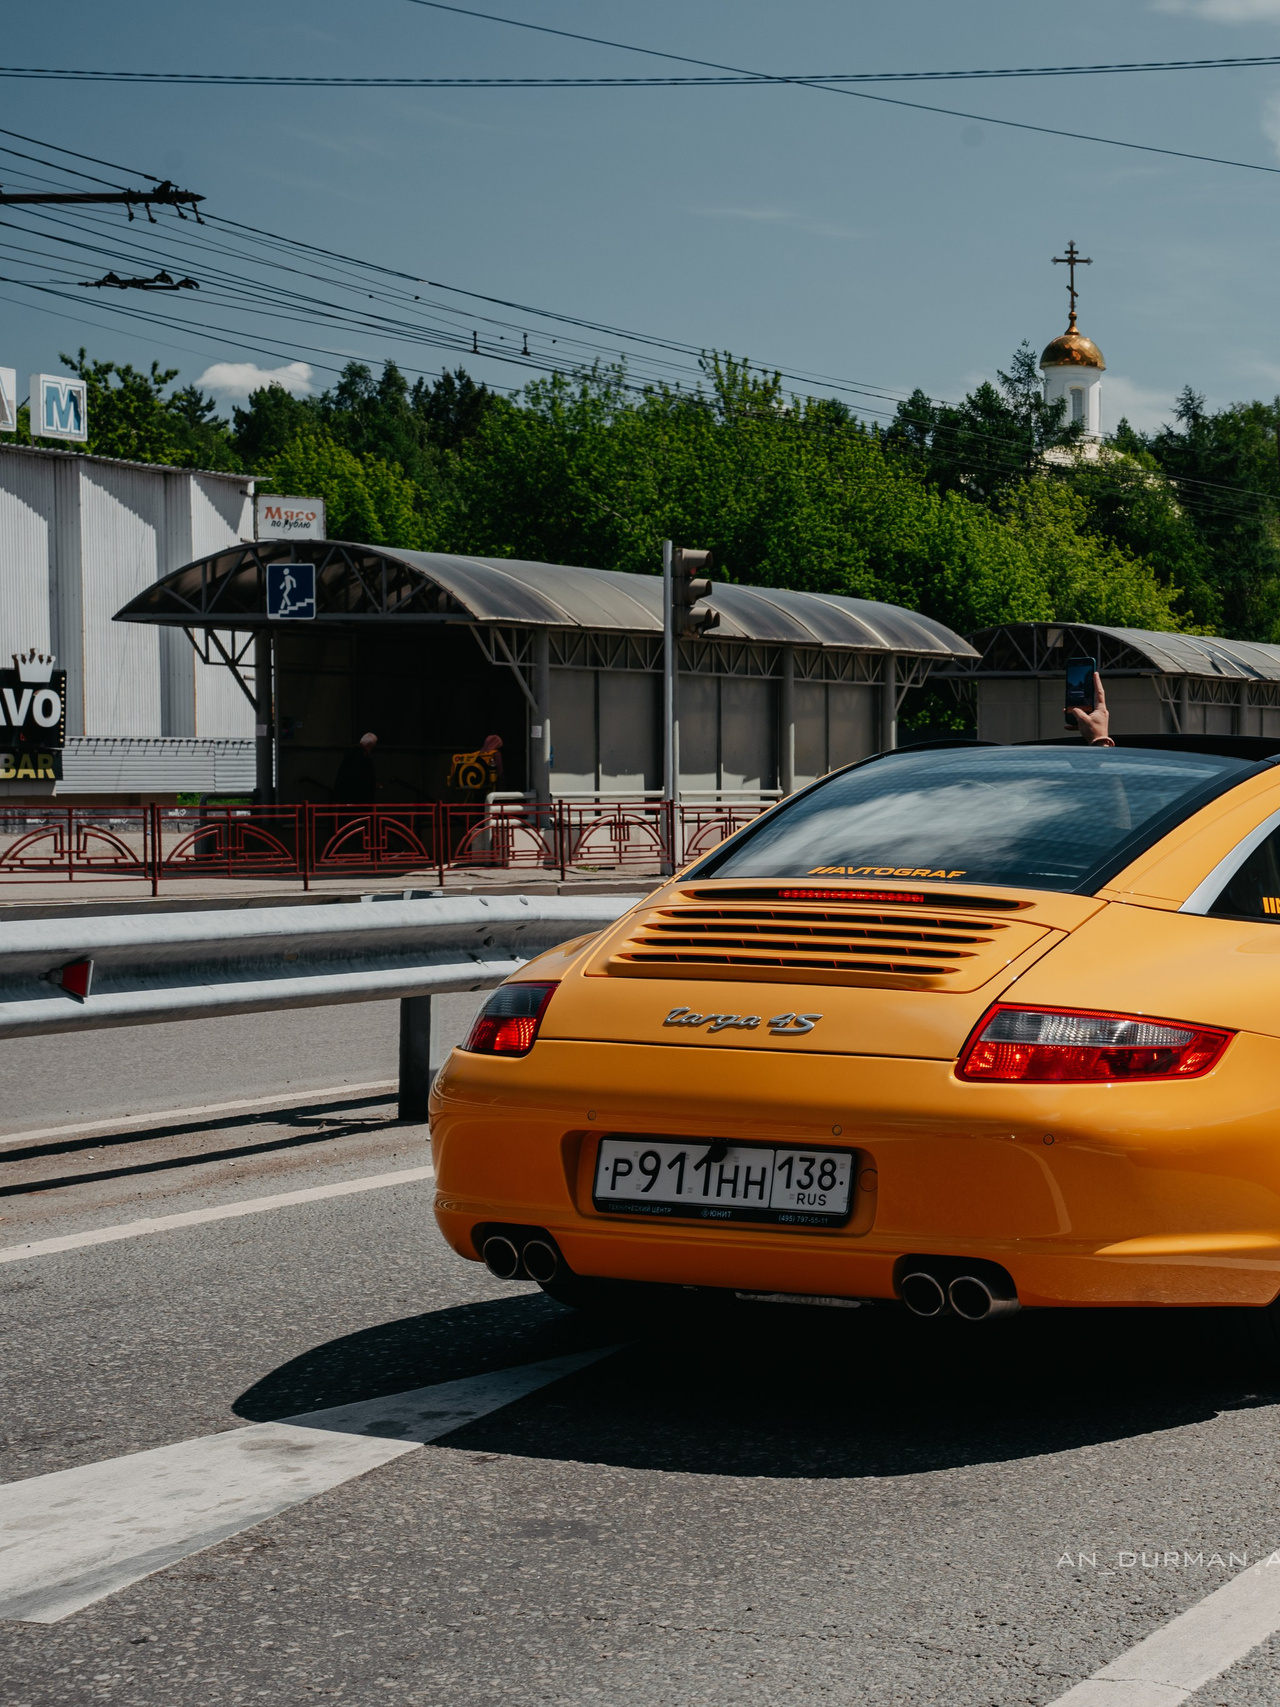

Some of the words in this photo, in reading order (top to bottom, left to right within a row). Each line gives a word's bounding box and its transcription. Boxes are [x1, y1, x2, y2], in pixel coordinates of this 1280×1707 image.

[264, 505, 317, 521] Мясо
[0, 688, 61, 728] VO
[0, 753, 56, 779] BAR
[769, 1012, 824, 1033] 4S
[777, 1155, 838, 1192] 138
[796, 1193, 827, 1206] RUS
[651, 1206, 673, 1214] ЦЕНТР
[709, 1209, 732, 1218] ЮНИТ
[778, 1214, 795, 1223] (495)
